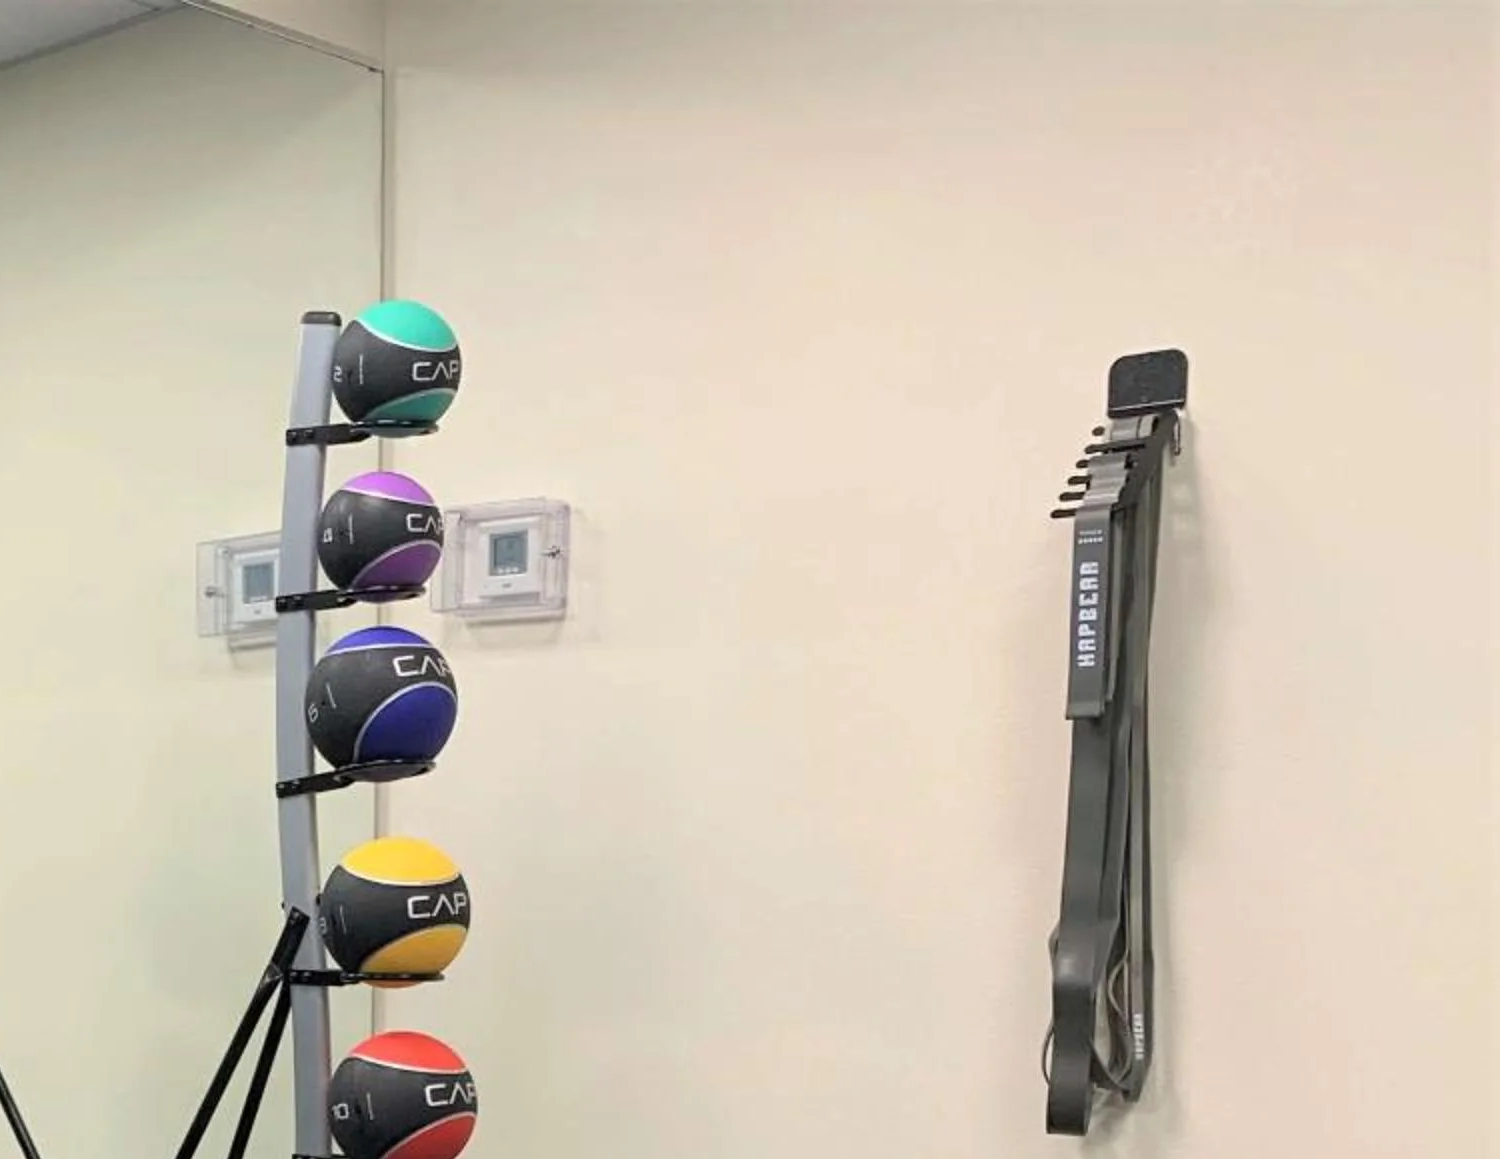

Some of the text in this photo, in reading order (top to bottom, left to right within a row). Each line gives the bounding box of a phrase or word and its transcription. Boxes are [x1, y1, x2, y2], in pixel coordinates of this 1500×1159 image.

[411, 358, 460, 382] CAP
[407, 891, 468, 919] CAP
[424, 1081, 476, 1107] CAP
